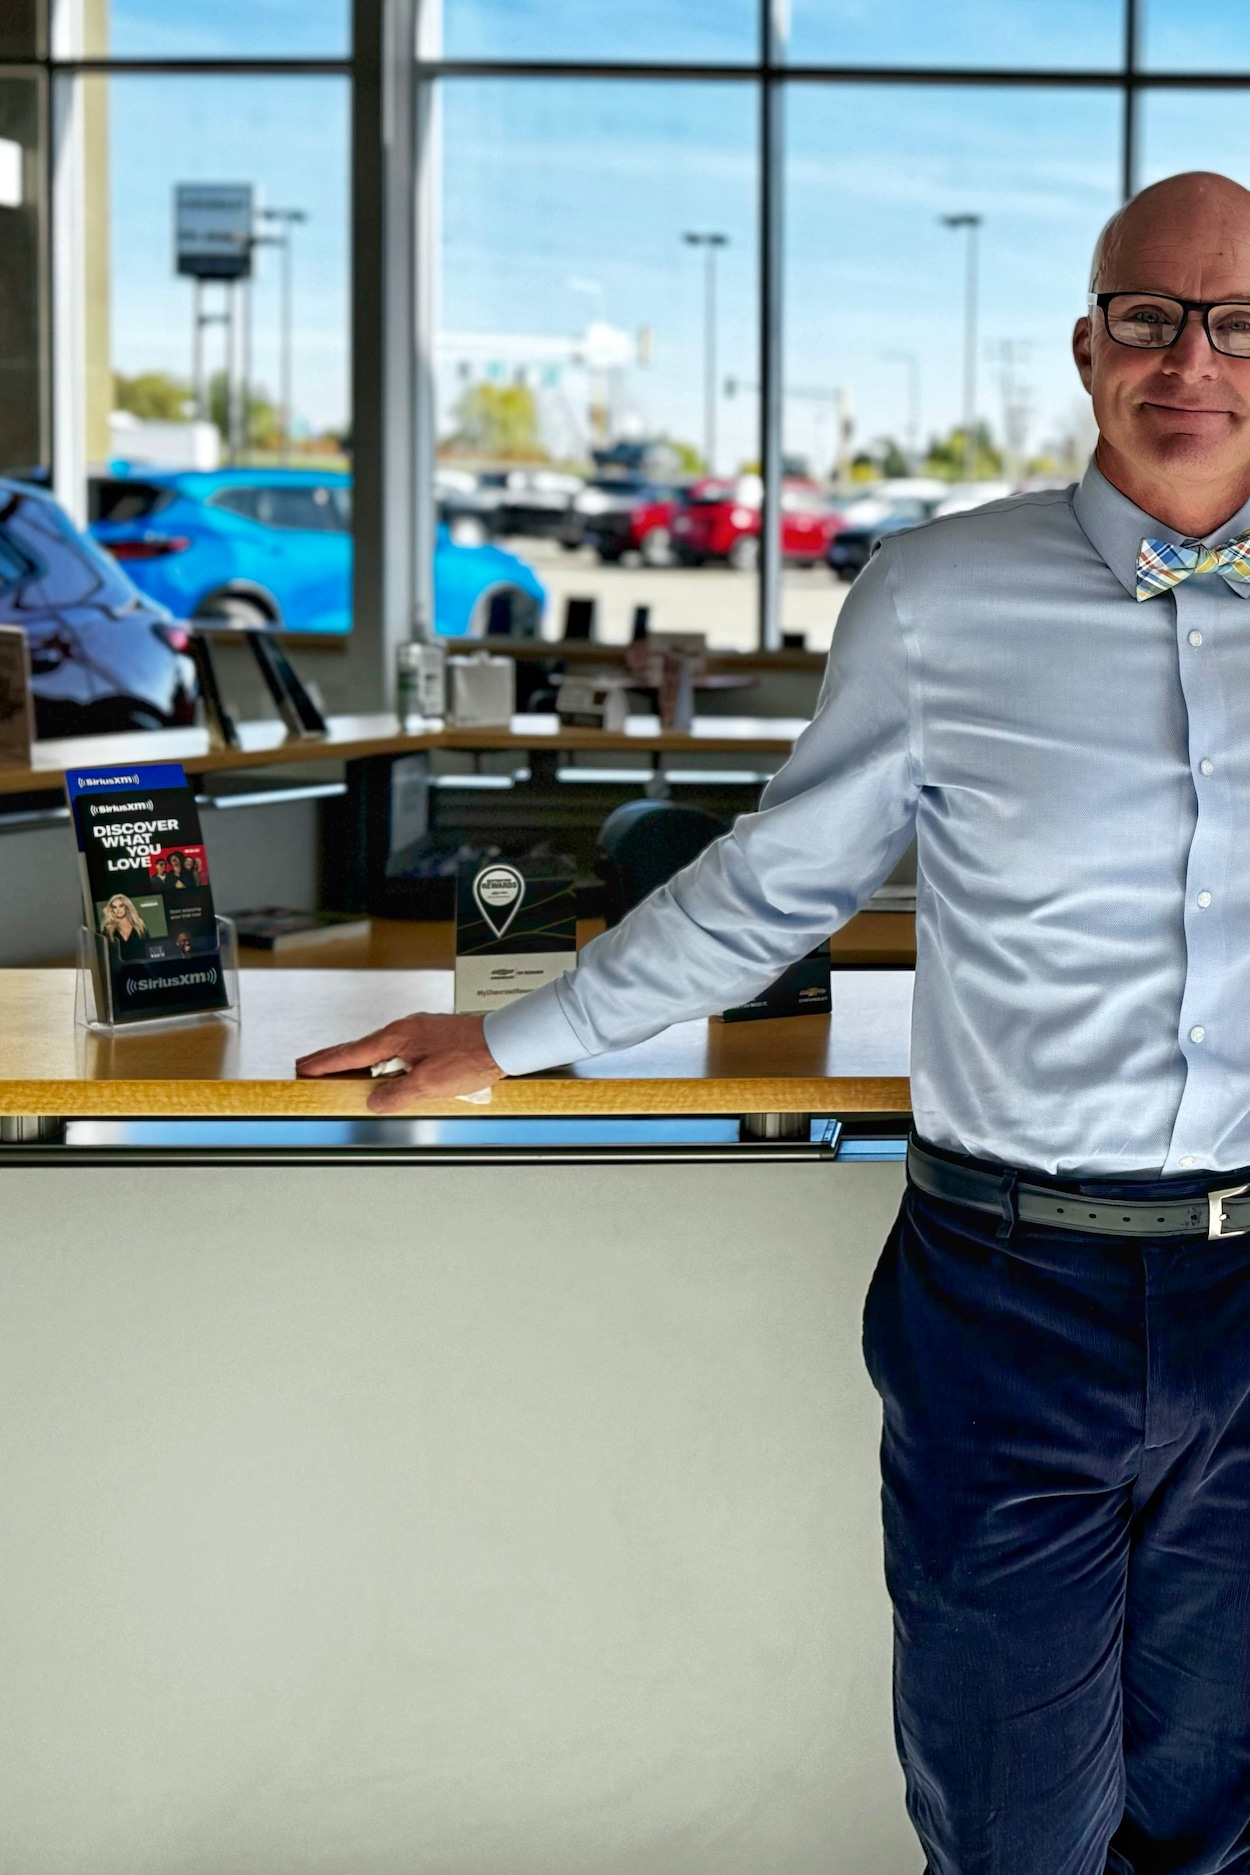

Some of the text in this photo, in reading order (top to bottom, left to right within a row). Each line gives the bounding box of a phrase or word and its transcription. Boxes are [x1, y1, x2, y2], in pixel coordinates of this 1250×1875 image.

[92, 818, 180, 838] DISCOVER
[101, 832, 153, 849] WHAT
[126, 843, 162, 857] YOU
[107, 856, 153, 872] LOVE
[481, 881, 517, 889] REWARDS
